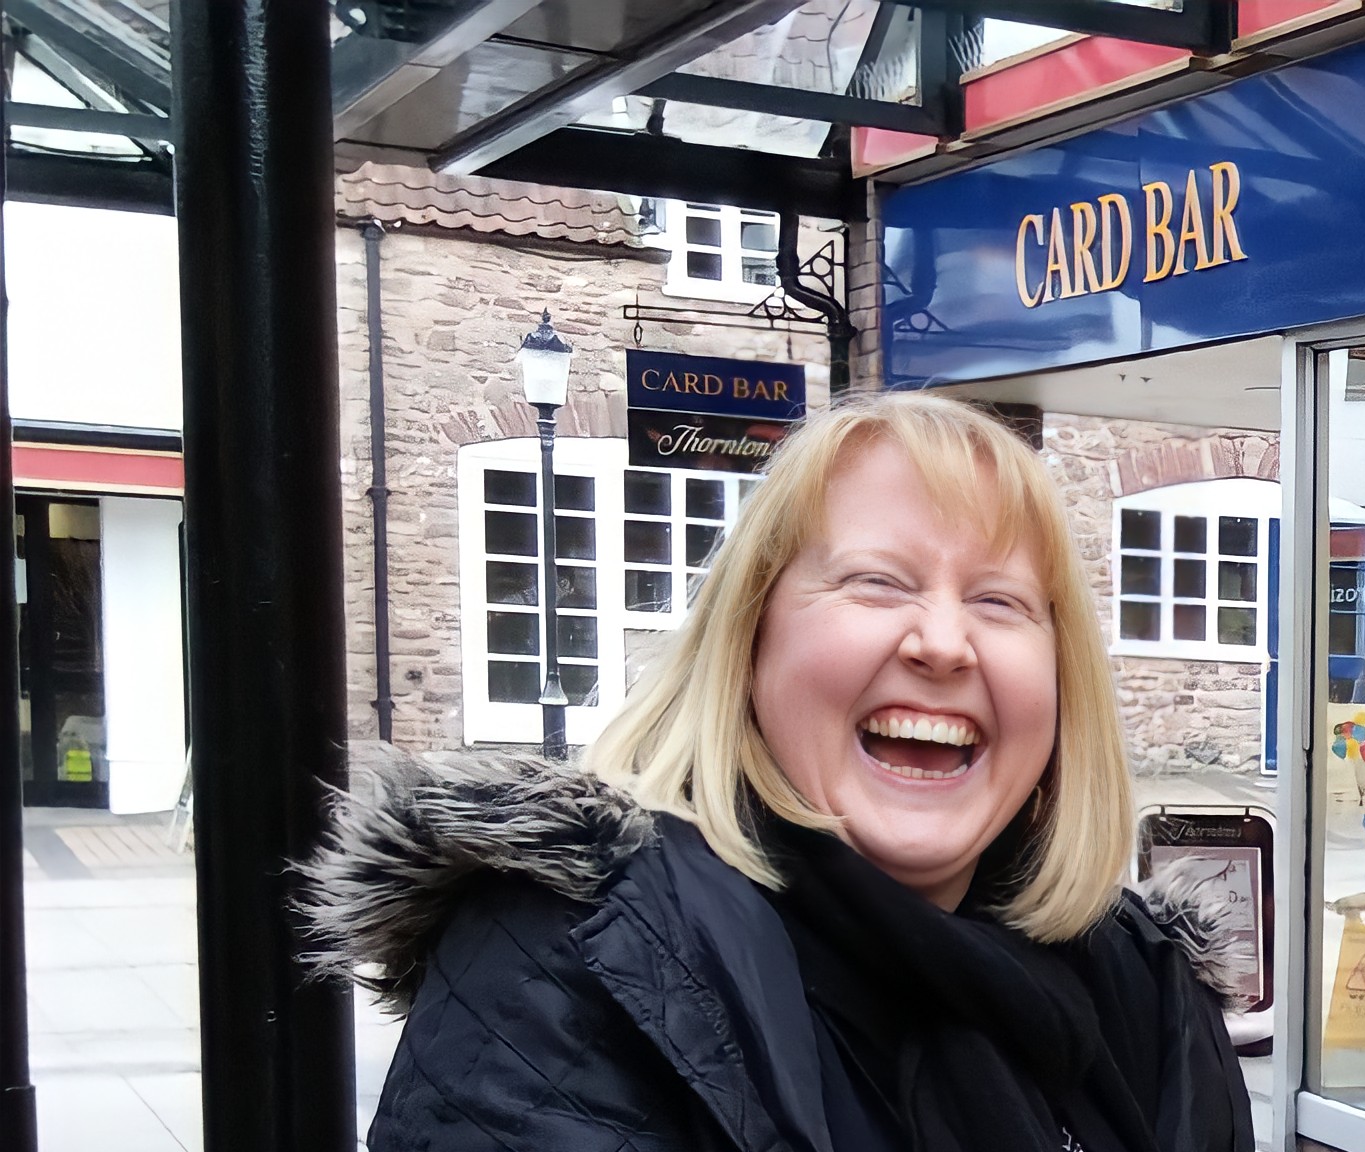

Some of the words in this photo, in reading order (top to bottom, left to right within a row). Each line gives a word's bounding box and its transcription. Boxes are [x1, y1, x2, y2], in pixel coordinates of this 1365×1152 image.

[1016, 193, 1133, 308] CARD
[1143, 161, 1248, 283] BAR
[641, 369, 723, 395] CARD
[733, 377, 796, 401] BAR
[657, 424, 774, 456] Thornton
